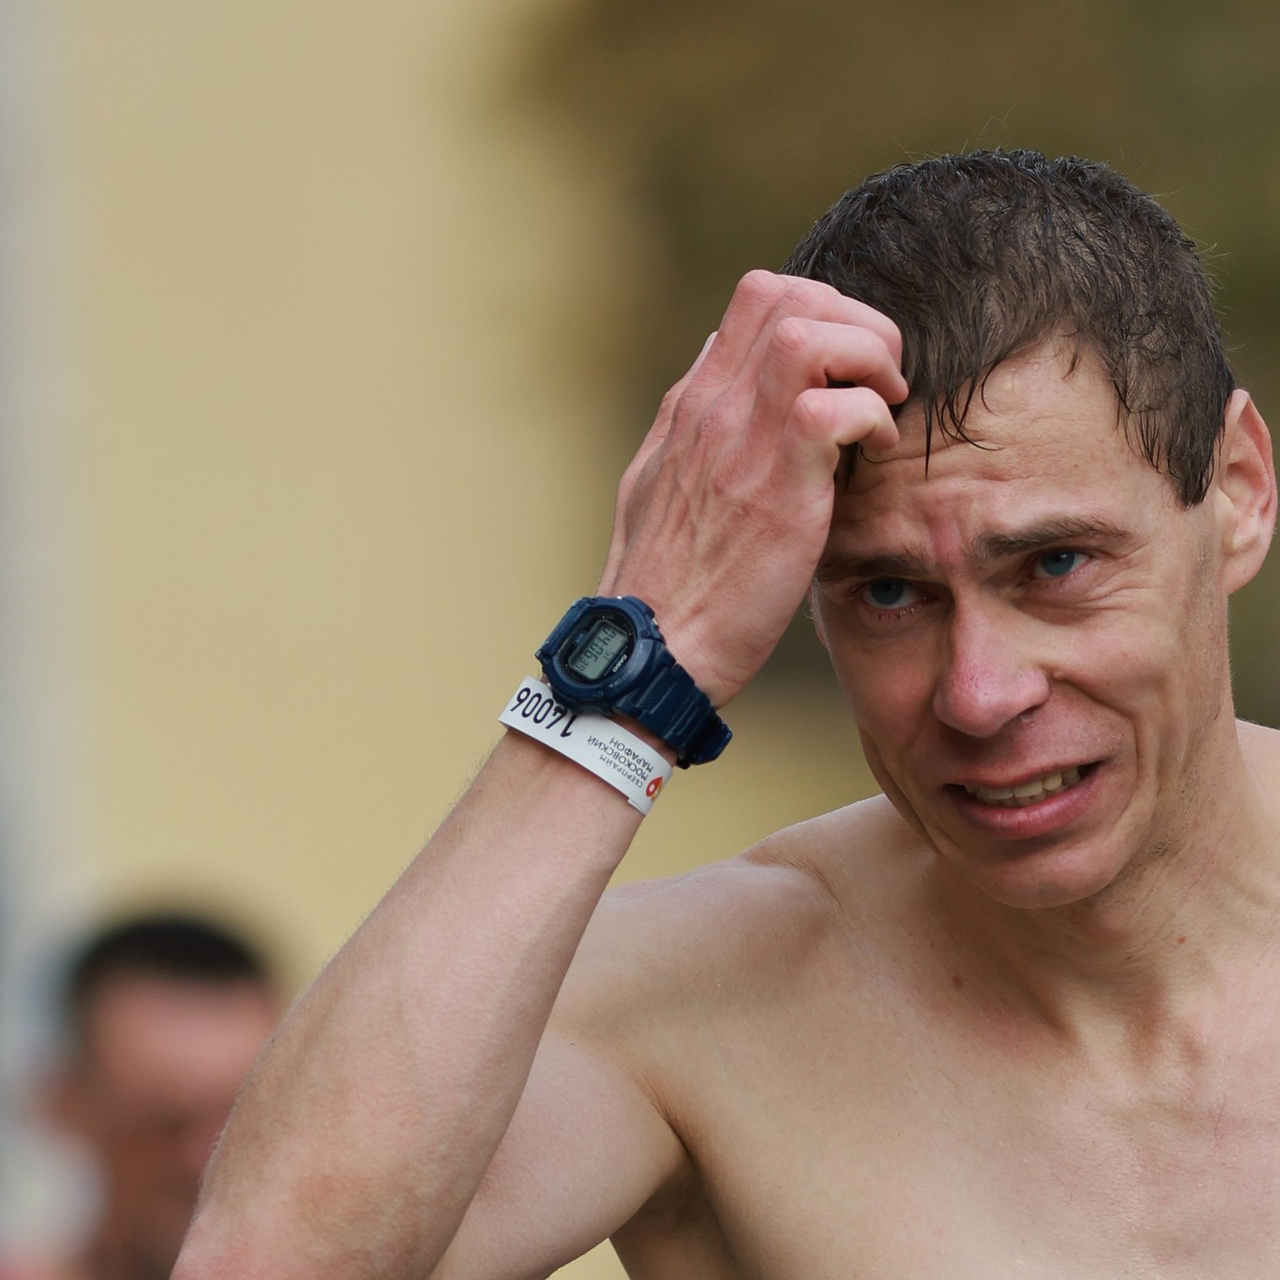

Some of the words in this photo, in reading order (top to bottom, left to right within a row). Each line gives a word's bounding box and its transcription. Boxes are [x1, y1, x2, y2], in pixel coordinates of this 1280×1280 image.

[612, 654, 628, 672] CASIO
[510, 687, 578, 738] 14006
[587, 735, 649, 781] МОСКОВСКИЙ
[599, 754, 643, 788] СБЕРПРАЙМ
[609, 737, 654, 772] МАРАФОН
